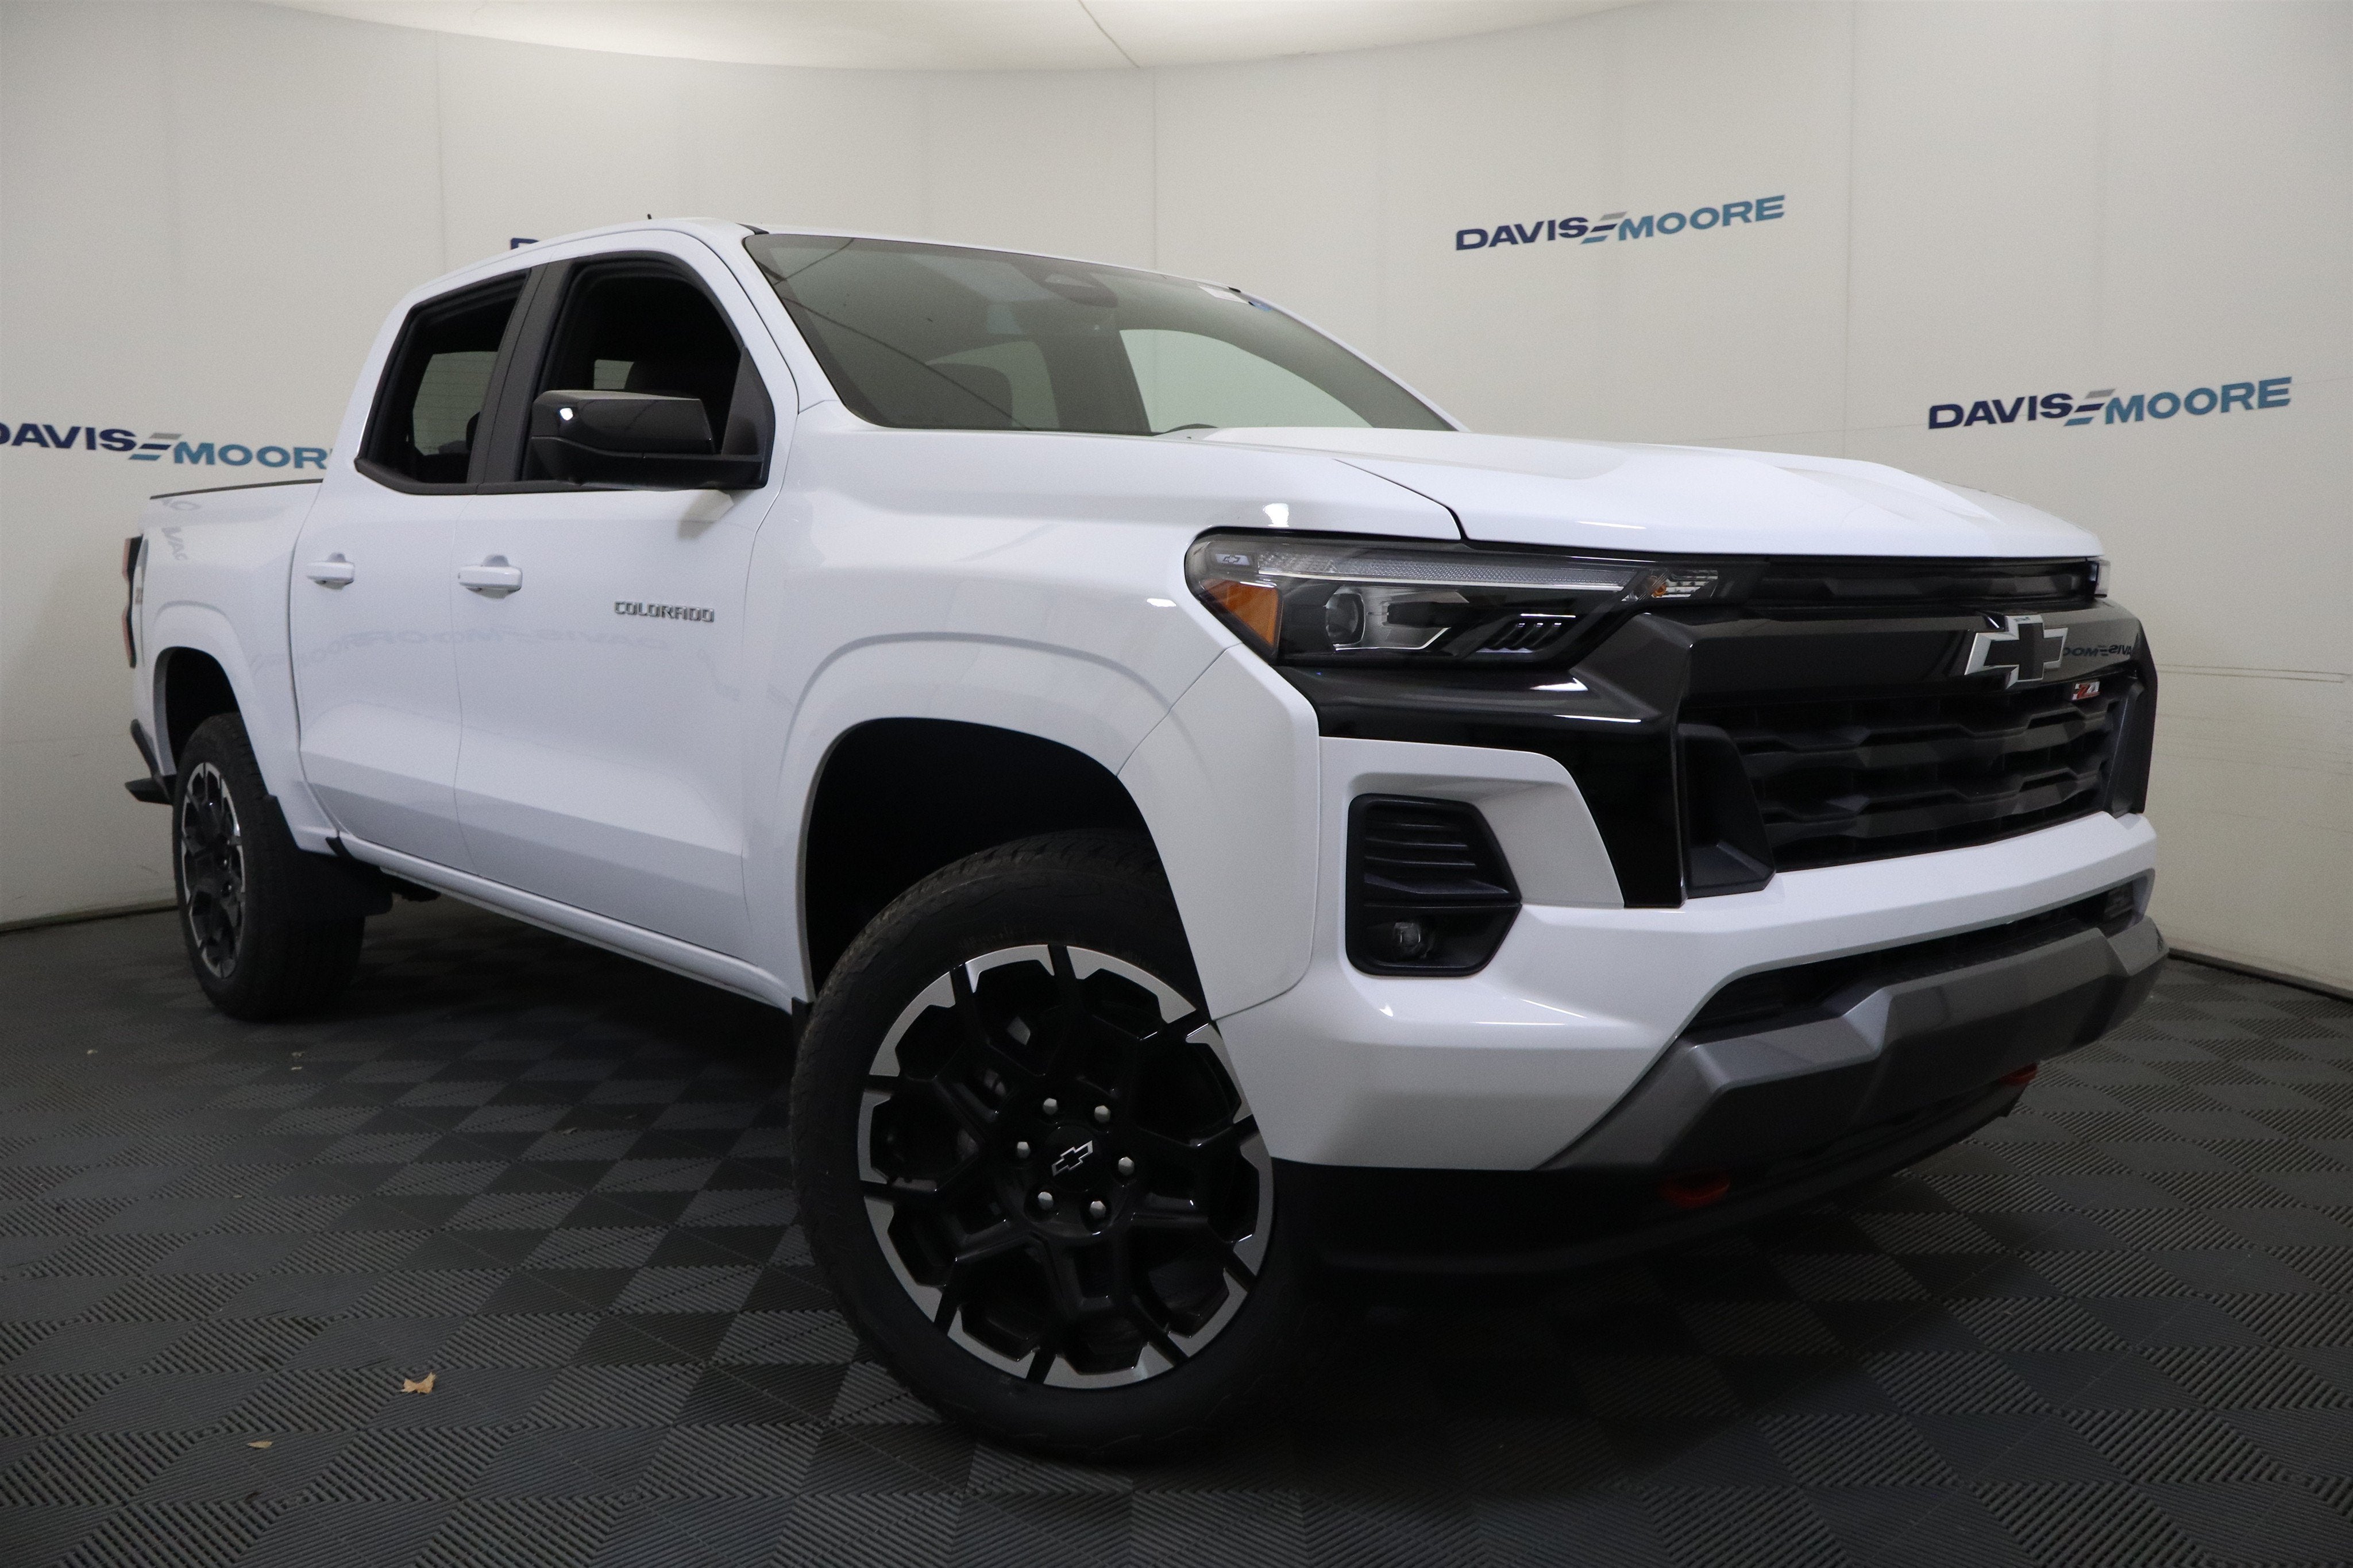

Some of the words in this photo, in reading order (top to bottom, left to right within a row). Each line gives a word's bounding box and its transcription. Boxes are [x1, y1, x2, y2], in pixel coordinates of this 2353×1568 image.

[1455, 216, 1590, 251] DAVIS
[1618, 195, 1785, 241] MOORE
[1928, 392, 2074, 430] DAVIS
[2105, 376, 2292, 425] MOORE
[0, 422, 138, 452] AVIS
[173, 441, 333, 470] MOOR
[614, 601, 715, 623] COLORADO
